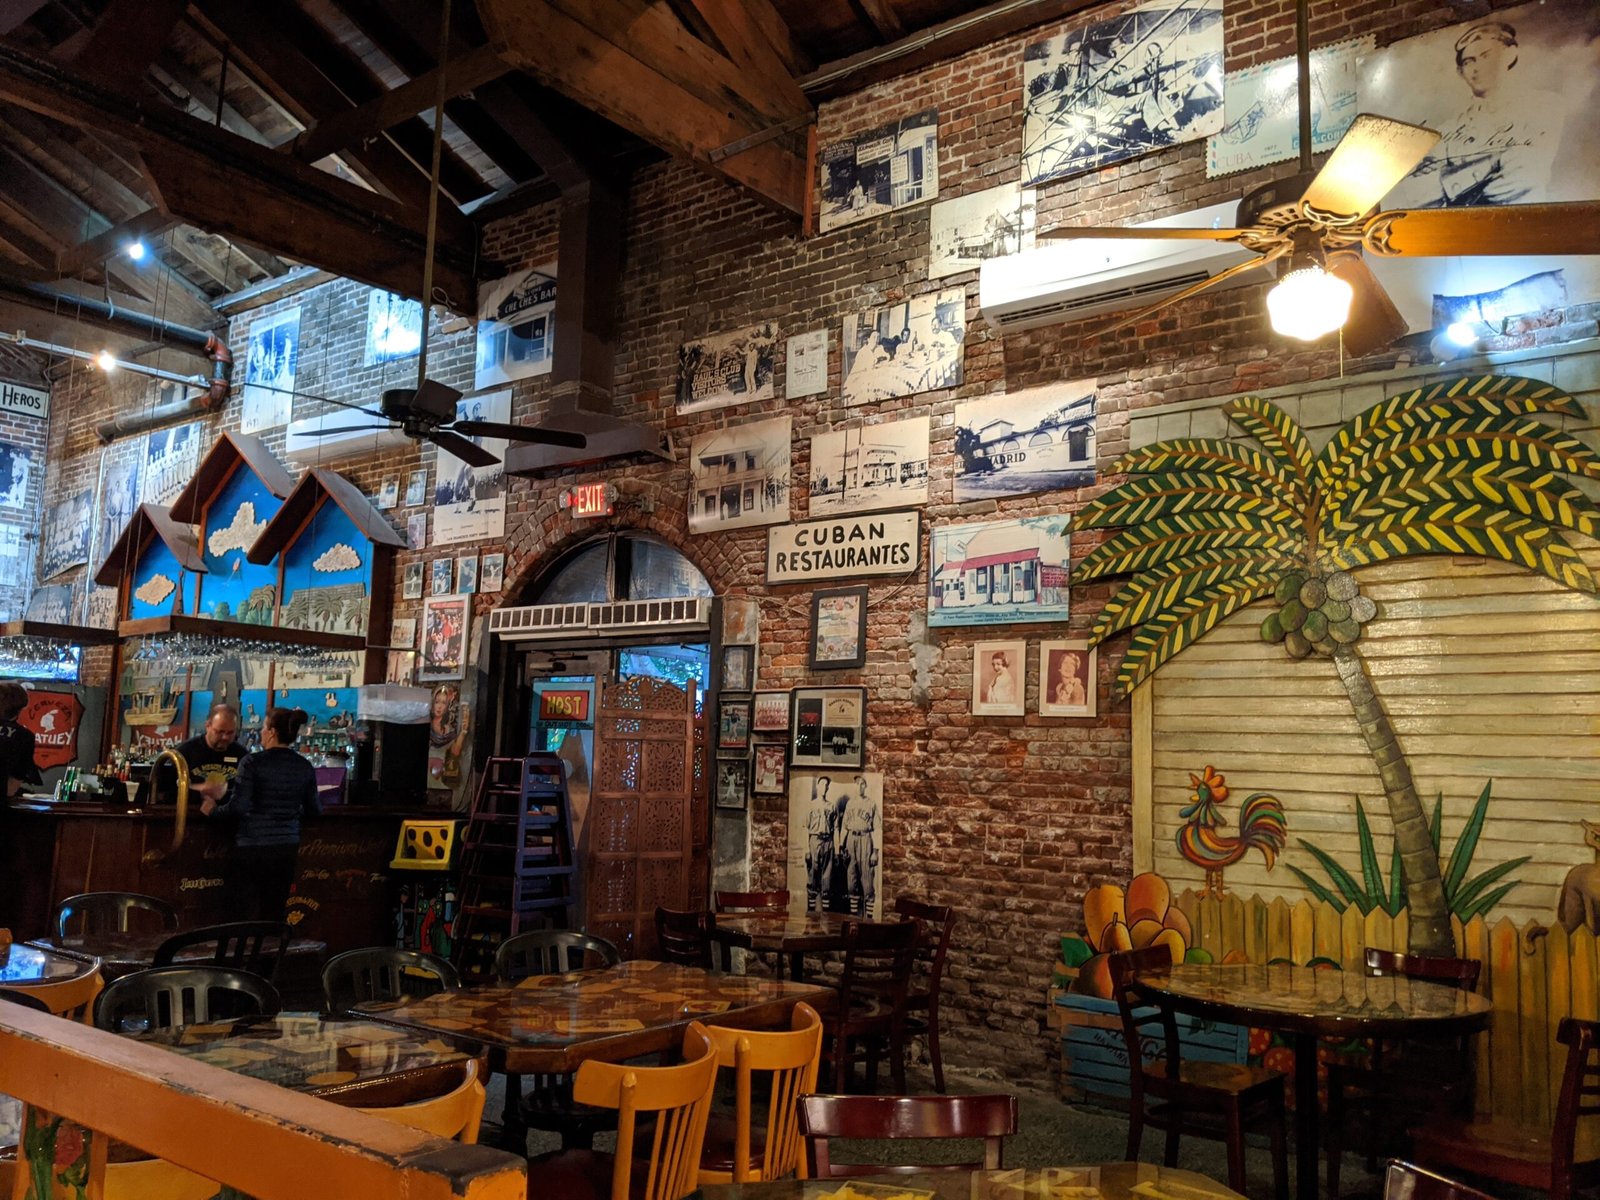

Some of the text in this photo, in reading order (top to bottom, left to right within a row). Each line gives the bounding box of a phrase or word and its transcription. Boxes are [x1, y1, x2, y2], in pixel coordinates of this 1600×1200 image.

[692, 375, 727, 391] VISITORS
[693, 364, 741, 383] RAUL'S CLUB
[2, 384, 41, 410] HEROS
[577, 485, 602, 513] EXIT
[794, 522, 884, 547] CUBAN
[776, 542, 910, 573] RESTAURANTES
[546, 695, 582, 715] HOST
[35, 727, 75, 745] ATUEY
